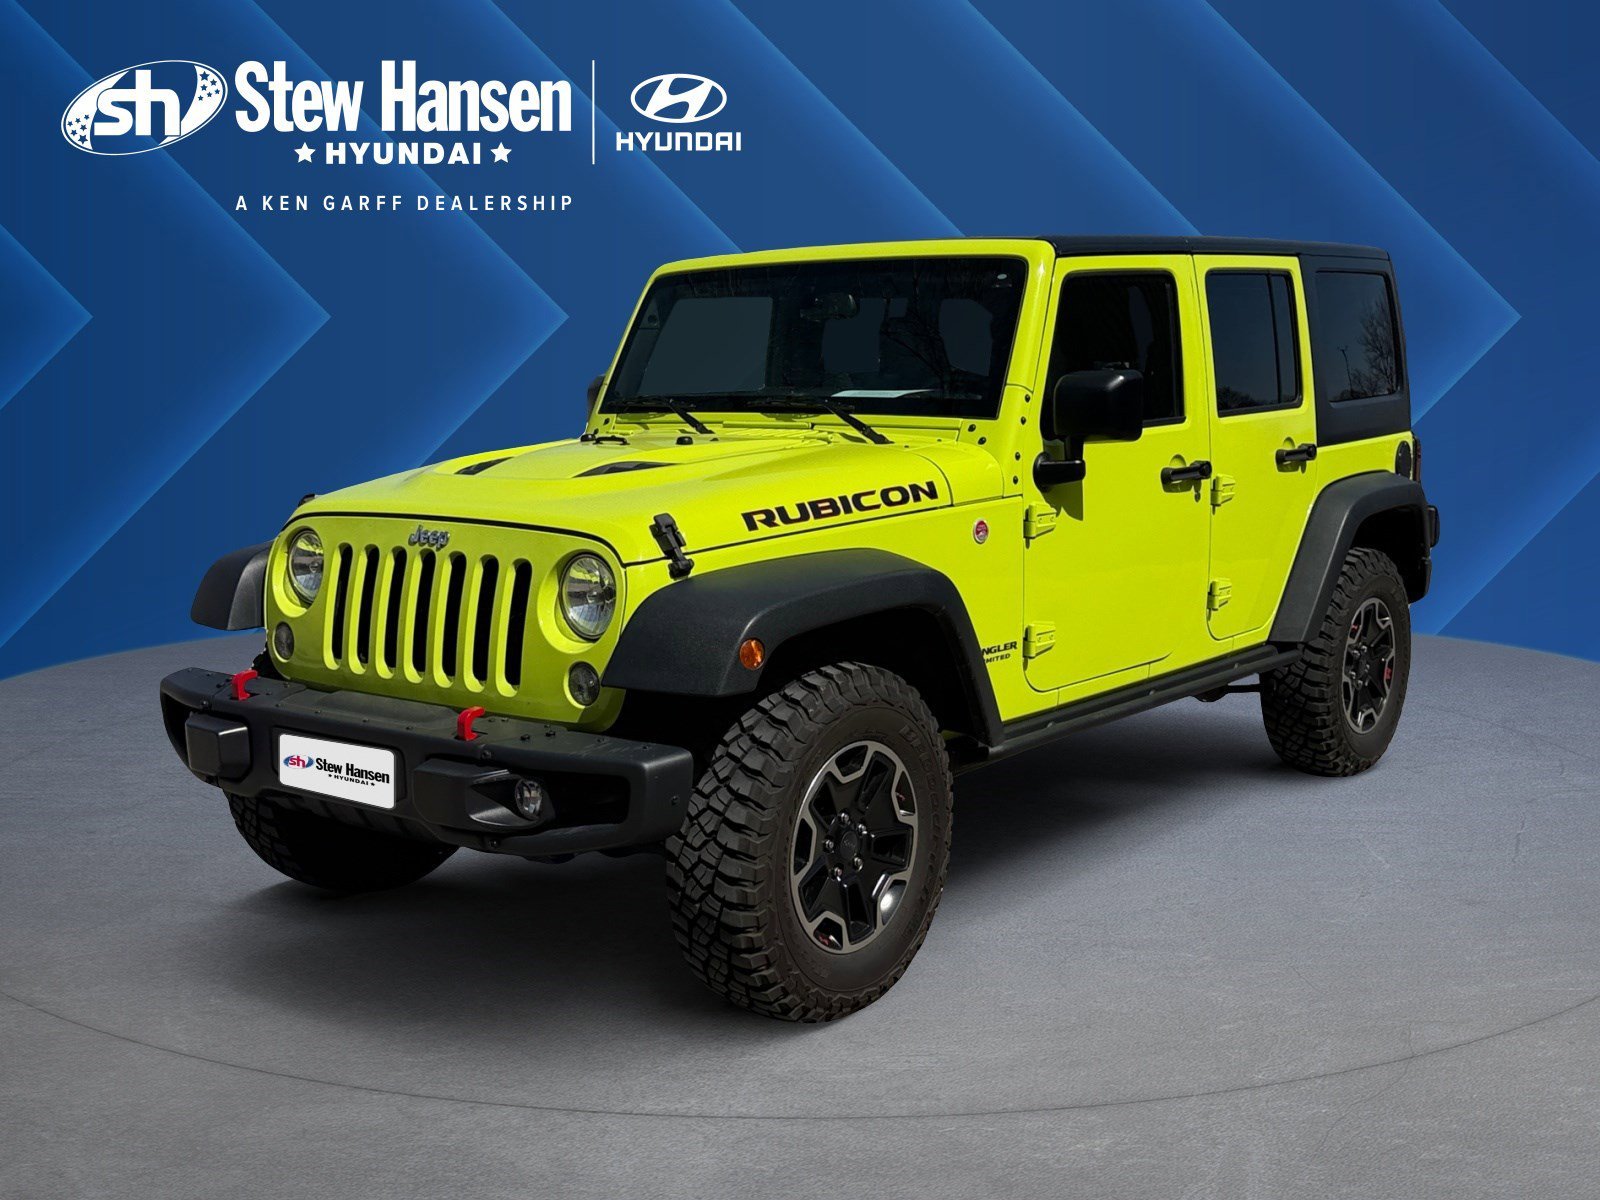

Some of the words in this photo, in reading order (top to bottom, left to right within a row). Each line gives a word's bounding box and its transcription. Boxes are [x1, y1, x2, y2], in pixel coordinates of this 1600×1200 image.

[741, 481, 938, 532] RUBICON
[408, 524, 450, 551] Jeep
[981, 641, 1018, 655] NGLER
[985, 653, 1011, 663] MITED
[316, 758, 342, 774] Stew
[346, 763, 389, 783] Hansen
[334, 774, 368, 785] HYUNDAI
